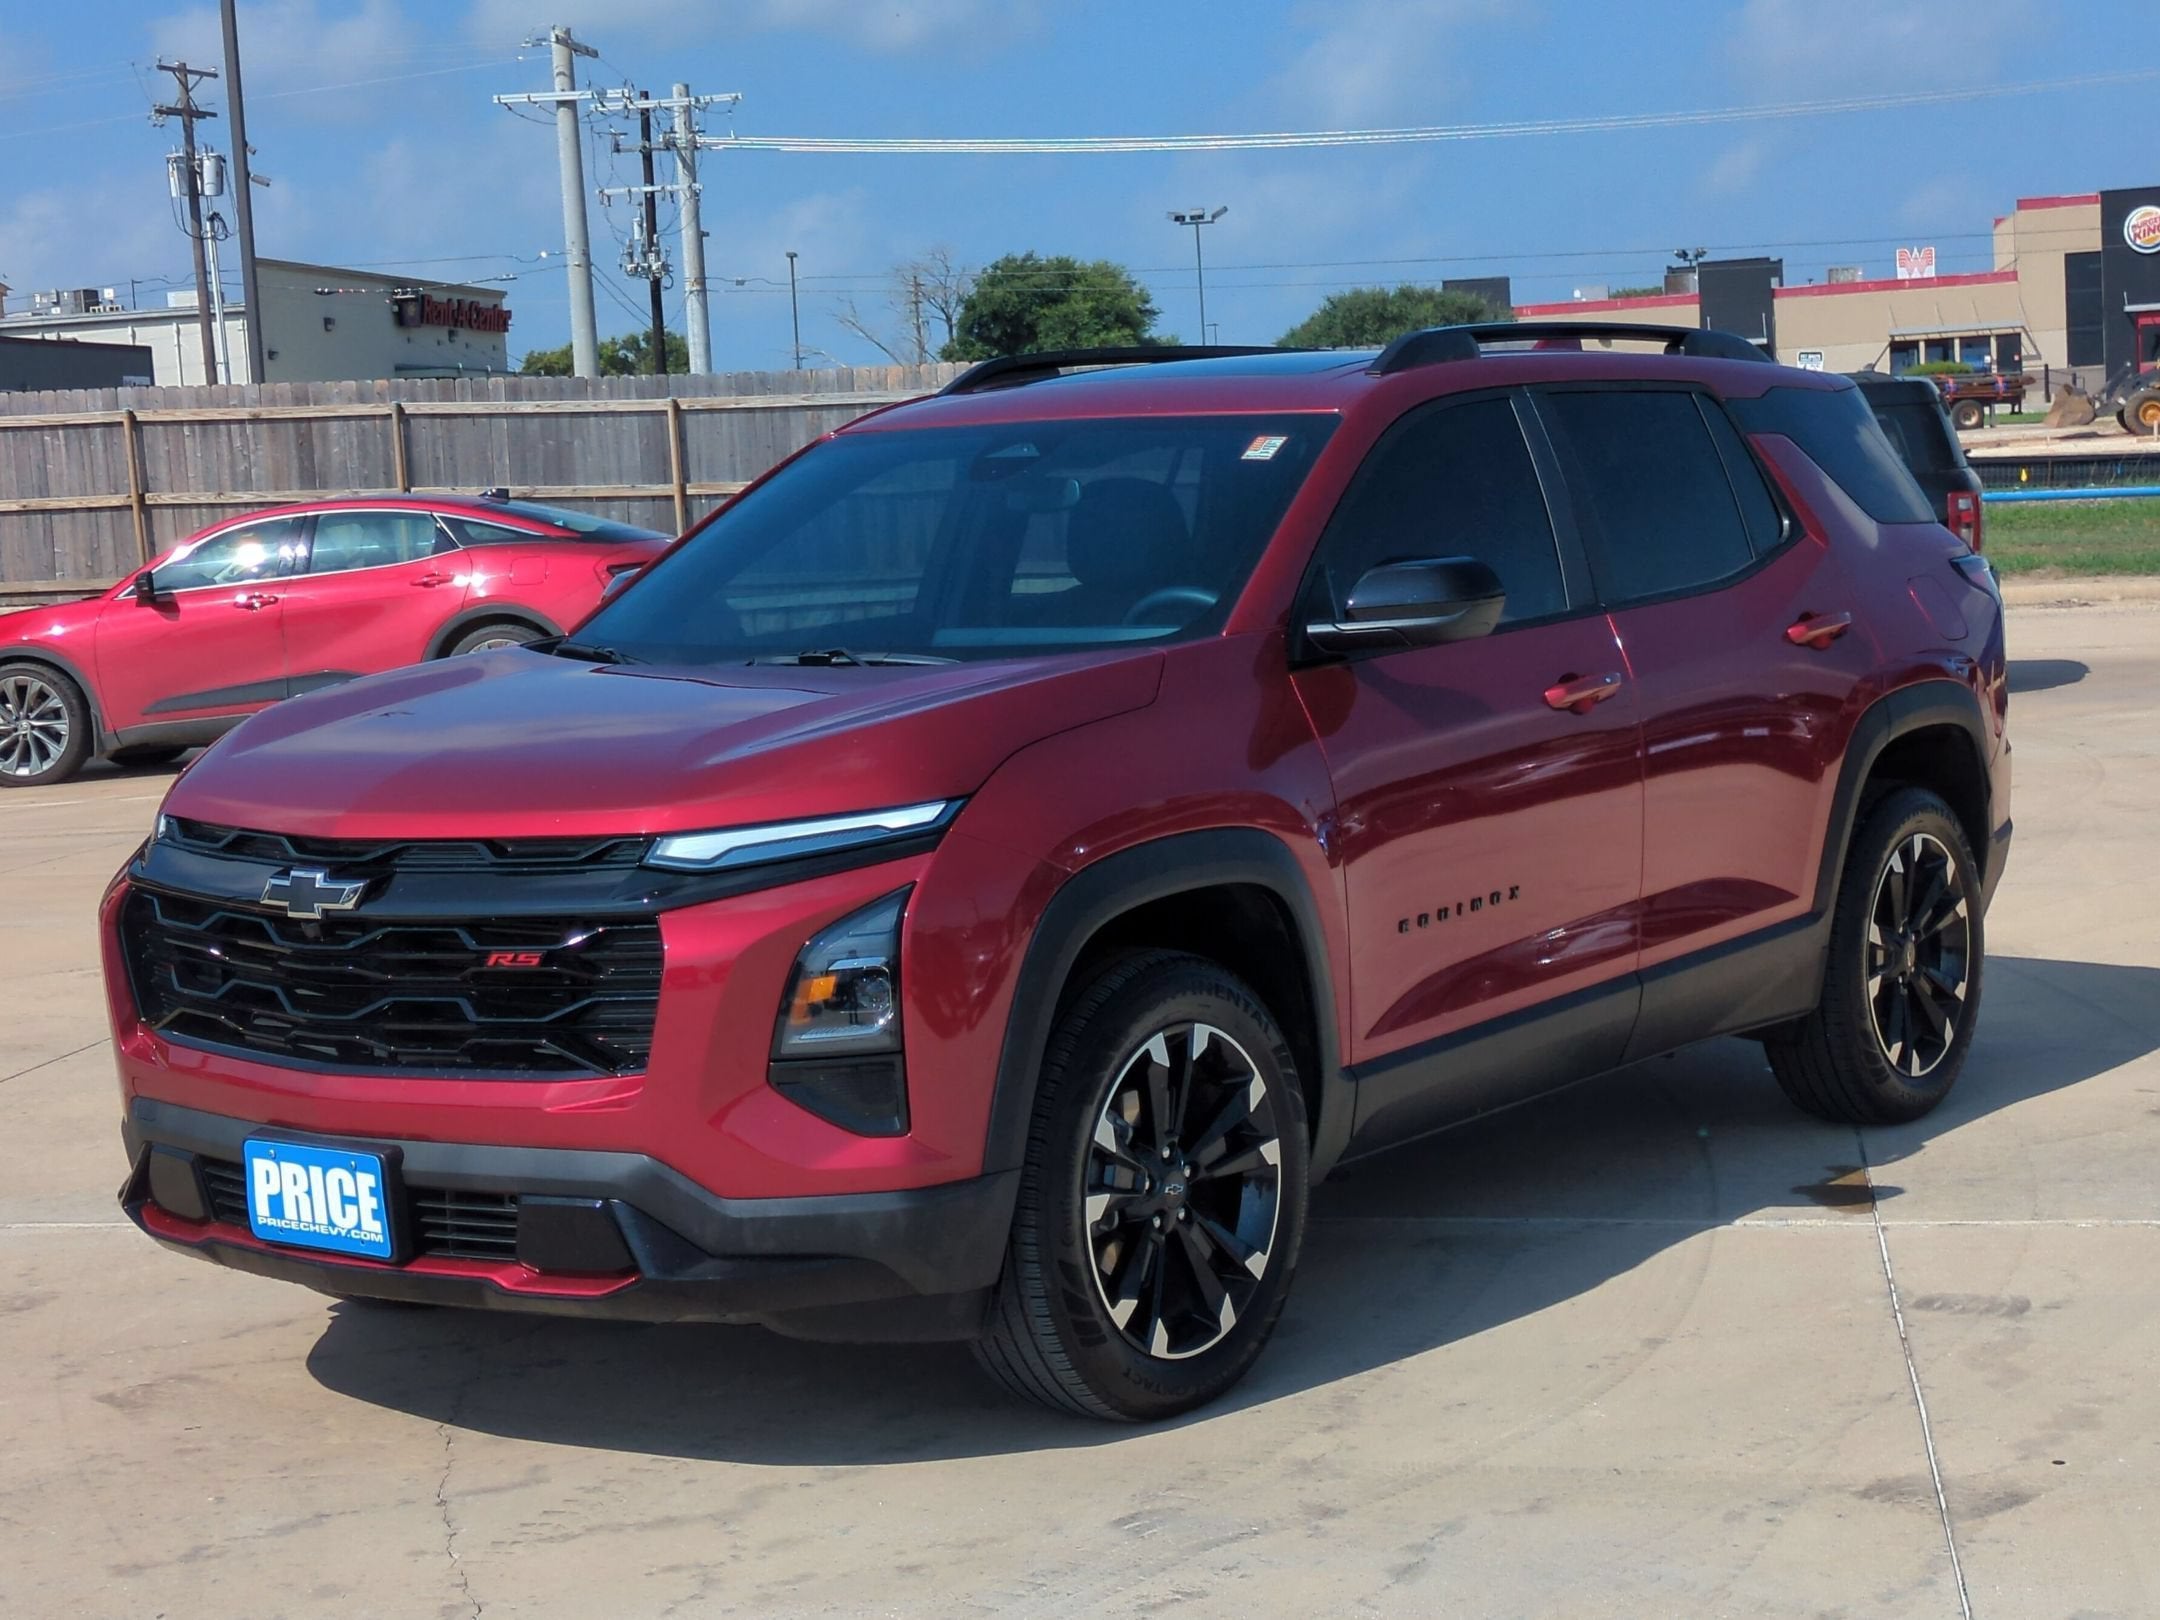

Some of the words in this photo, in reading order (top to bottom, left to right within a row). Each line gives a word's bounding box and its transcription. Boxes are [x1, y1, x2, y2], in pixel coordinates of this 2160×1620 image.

[2131, 216, 2160, 231] BURGE
[421, 294, 512, 332] Rent-A-Center
[1398, 885, 1520, 933] EQUINOX
[486, 952, 542, 967] RS
[252, 1157, 382, 1233] PRICE
[257, 1216, 384, 1243] PRICECHEVY.COM
